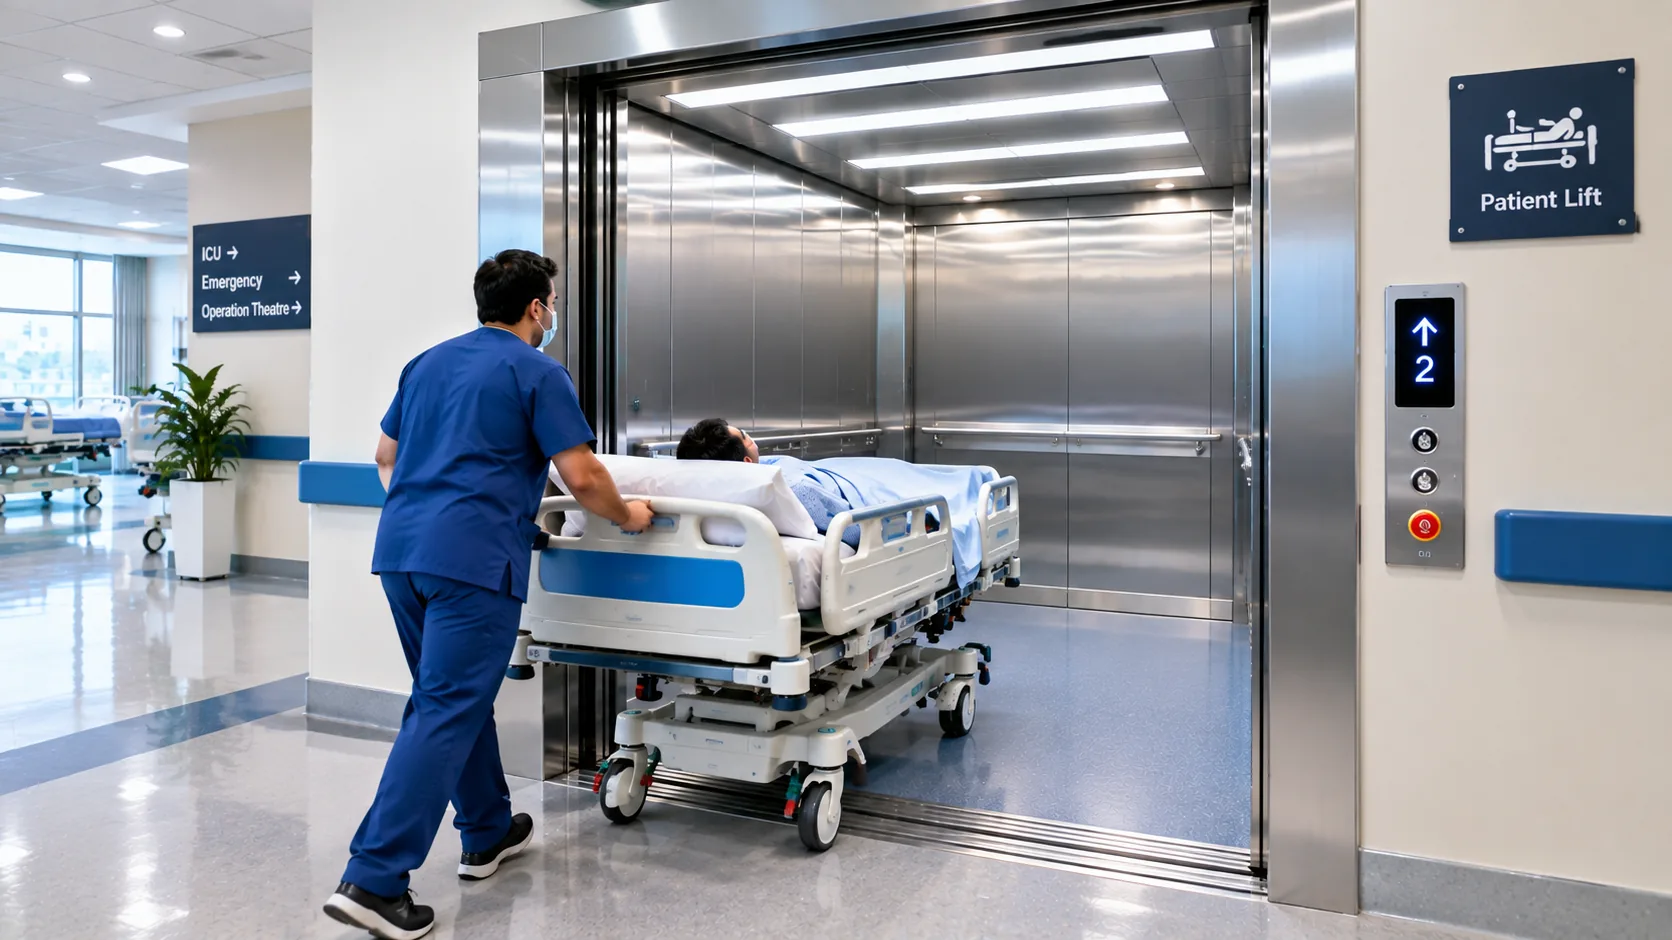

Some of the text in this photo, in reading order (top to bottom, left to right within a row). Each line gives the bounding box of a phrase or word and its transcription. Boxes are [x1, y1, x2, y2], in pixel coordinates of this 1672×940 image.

[1481, 186, 1602, 212] Patient Lift
[201, 245, 222, 262] ICU
[201, 274, 263, 292] Emergency
[201, 301, 290, 321] Operation Theatre
[1415, 355, 1435, 383] 2
